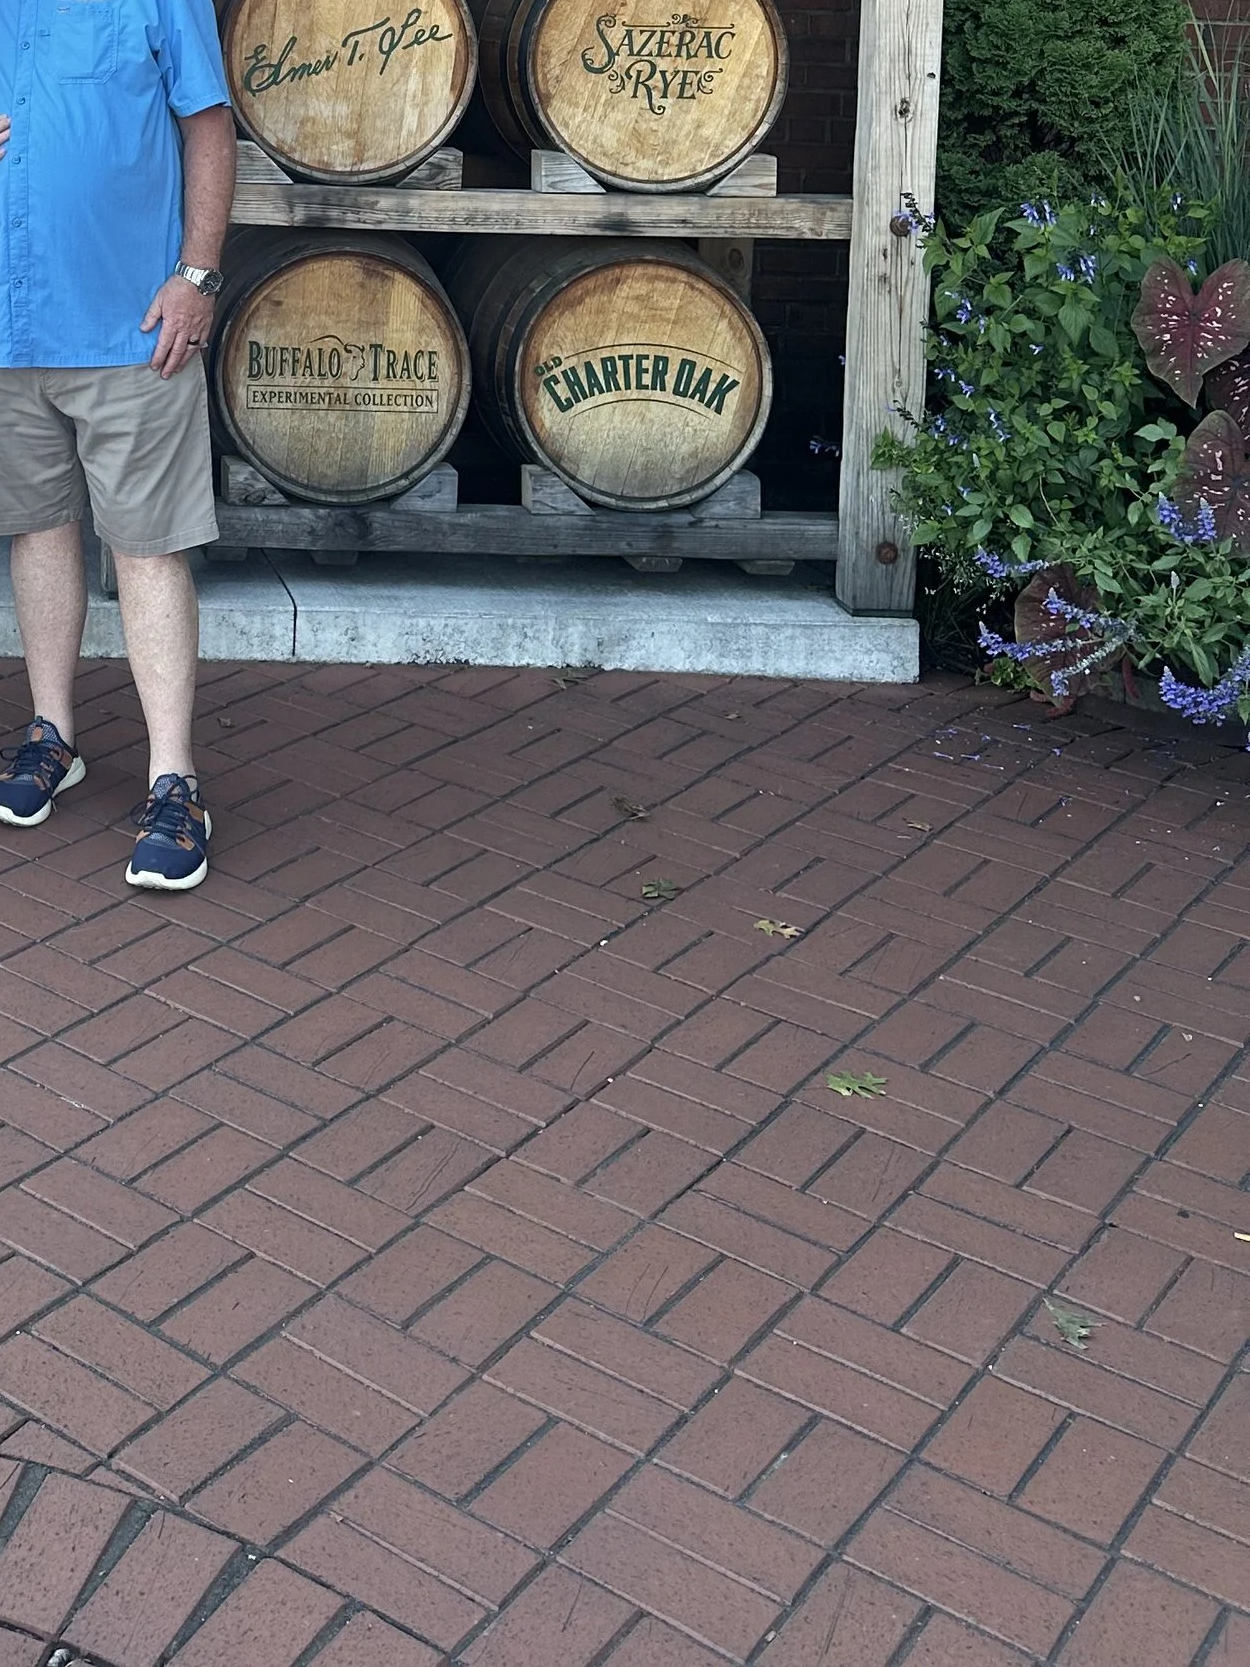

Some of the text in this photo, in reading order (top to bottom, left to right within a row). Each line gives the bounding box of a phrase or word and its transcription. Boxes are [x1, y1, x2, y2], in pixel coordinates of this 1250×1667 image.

[244, 35, 338, 97] Elmer
[341, 16, 391, 66] T.
[581, 13, 736, 74] SAZERAC
[624, 59, 700, 115] RYE
[247, 340, 439, 382] BUFFALO TRACE
[533, 355, 564, 377] OLD
[542, 353, 741, 416] CHARTER OAK
[251, 389, 434, 409] EXPERIMENTAL COLLECTION
